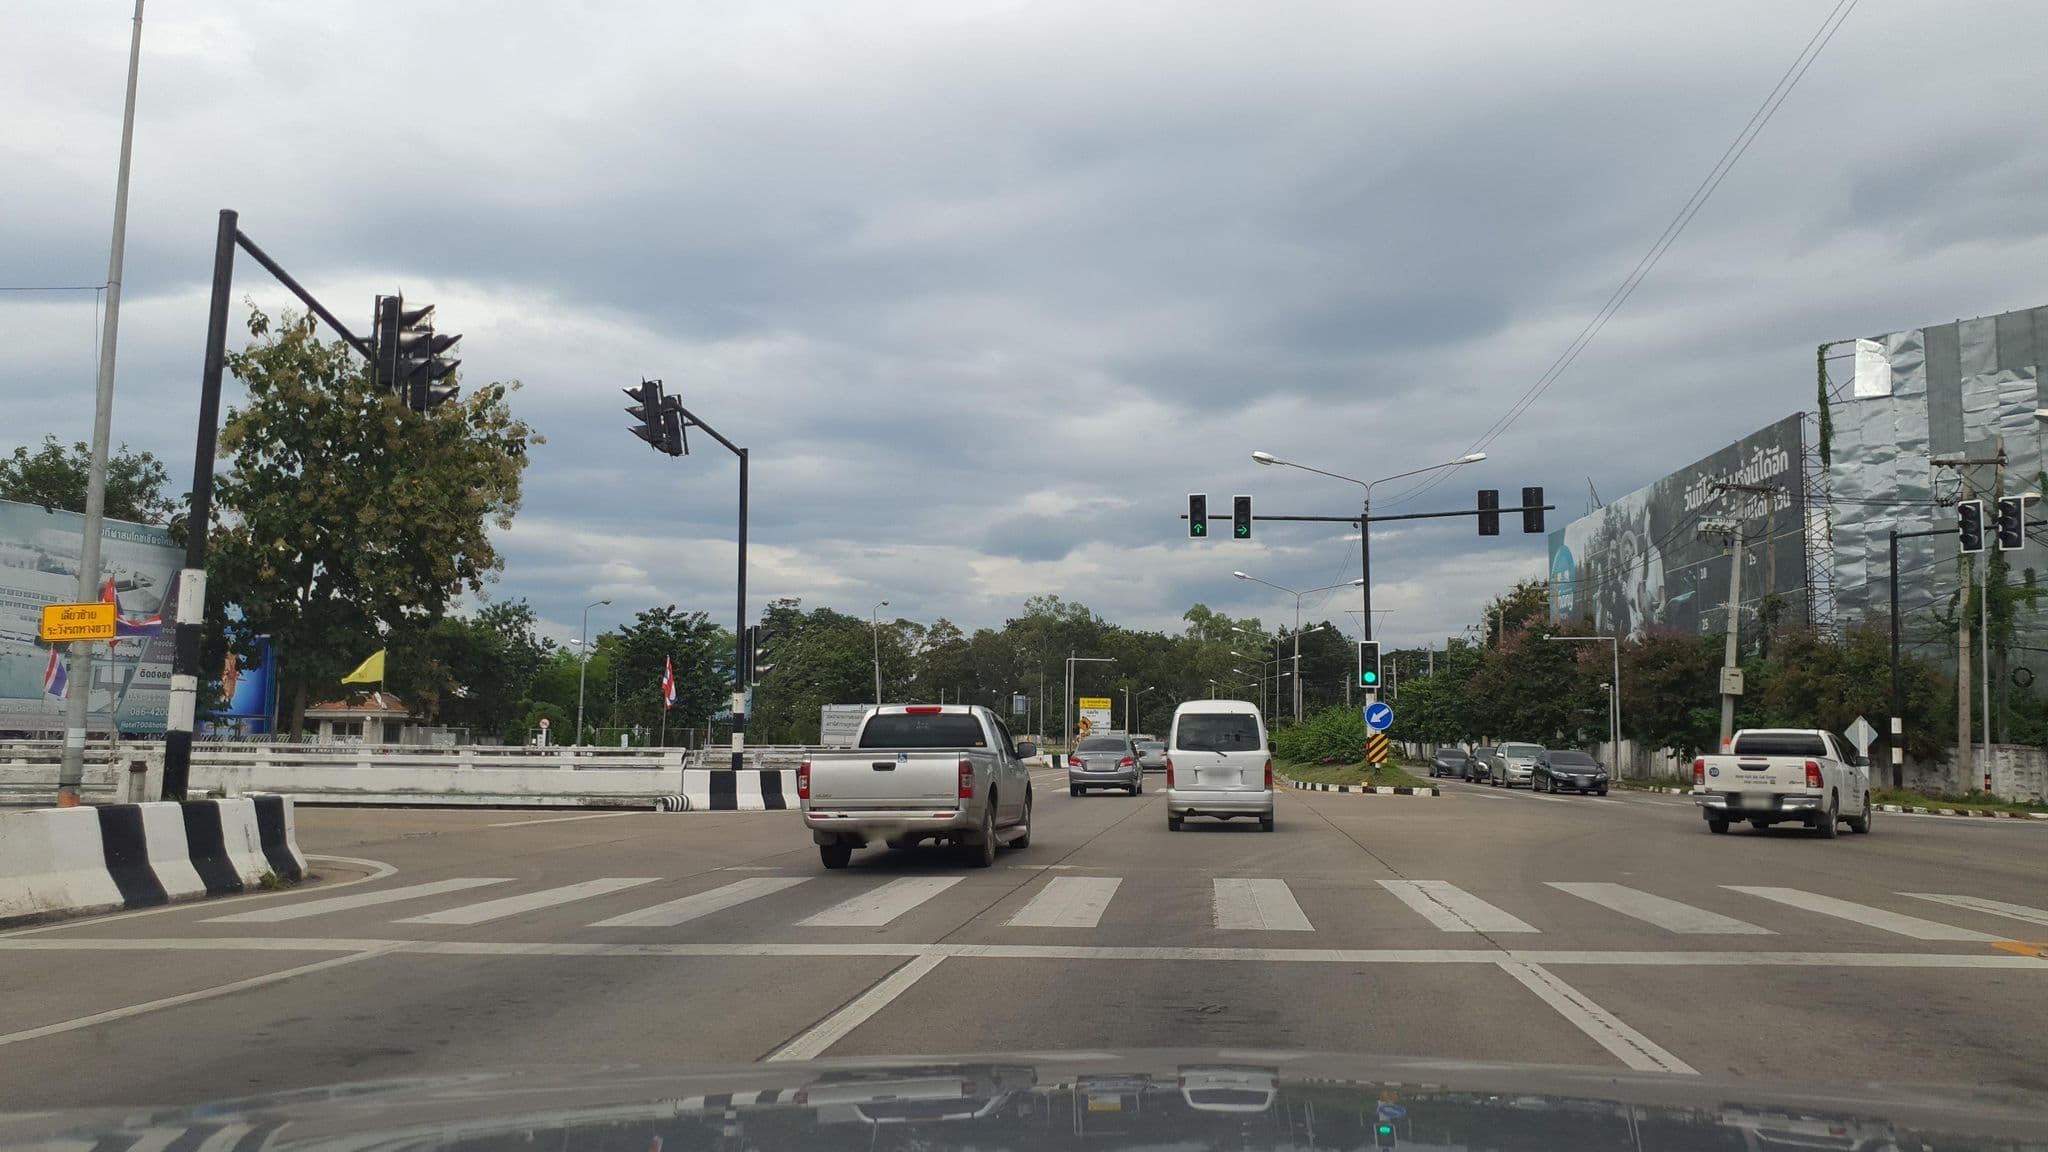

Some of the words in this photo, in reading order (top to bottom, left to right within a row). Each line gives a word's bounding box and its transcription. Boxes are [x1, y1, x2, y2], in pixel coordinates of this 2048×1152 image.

[61, 608, 97, 621] เลี้ยวซ้าย
[47, 623, 112, 636] ระวังรถทางขวา
